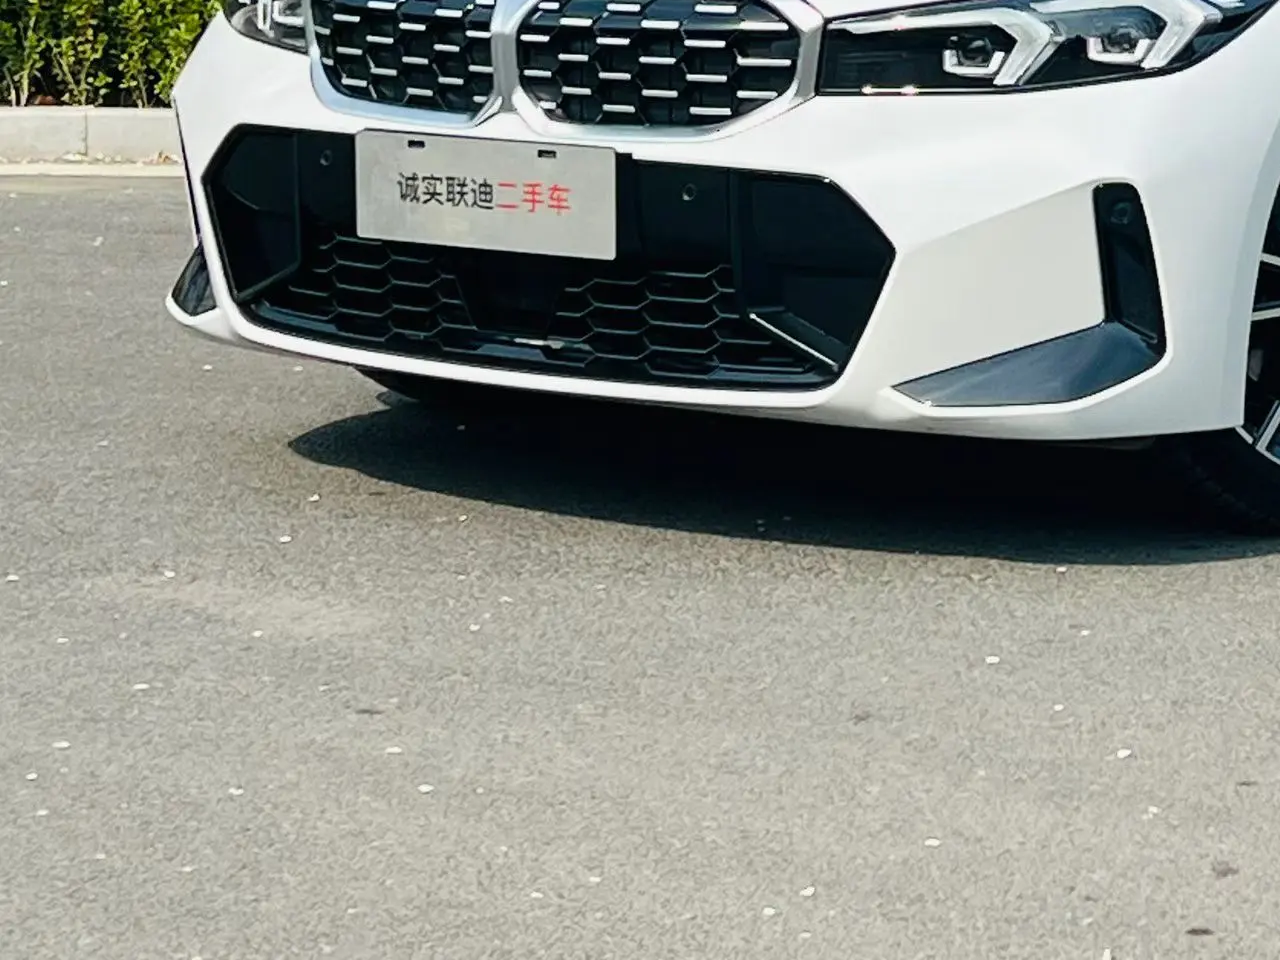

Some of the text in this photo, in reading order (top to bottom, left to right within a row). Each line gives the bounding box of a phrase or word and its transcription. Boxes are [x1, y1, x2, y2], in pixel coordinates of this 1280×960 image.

[397, 172, 571, 215] 诚实联迪二手车
